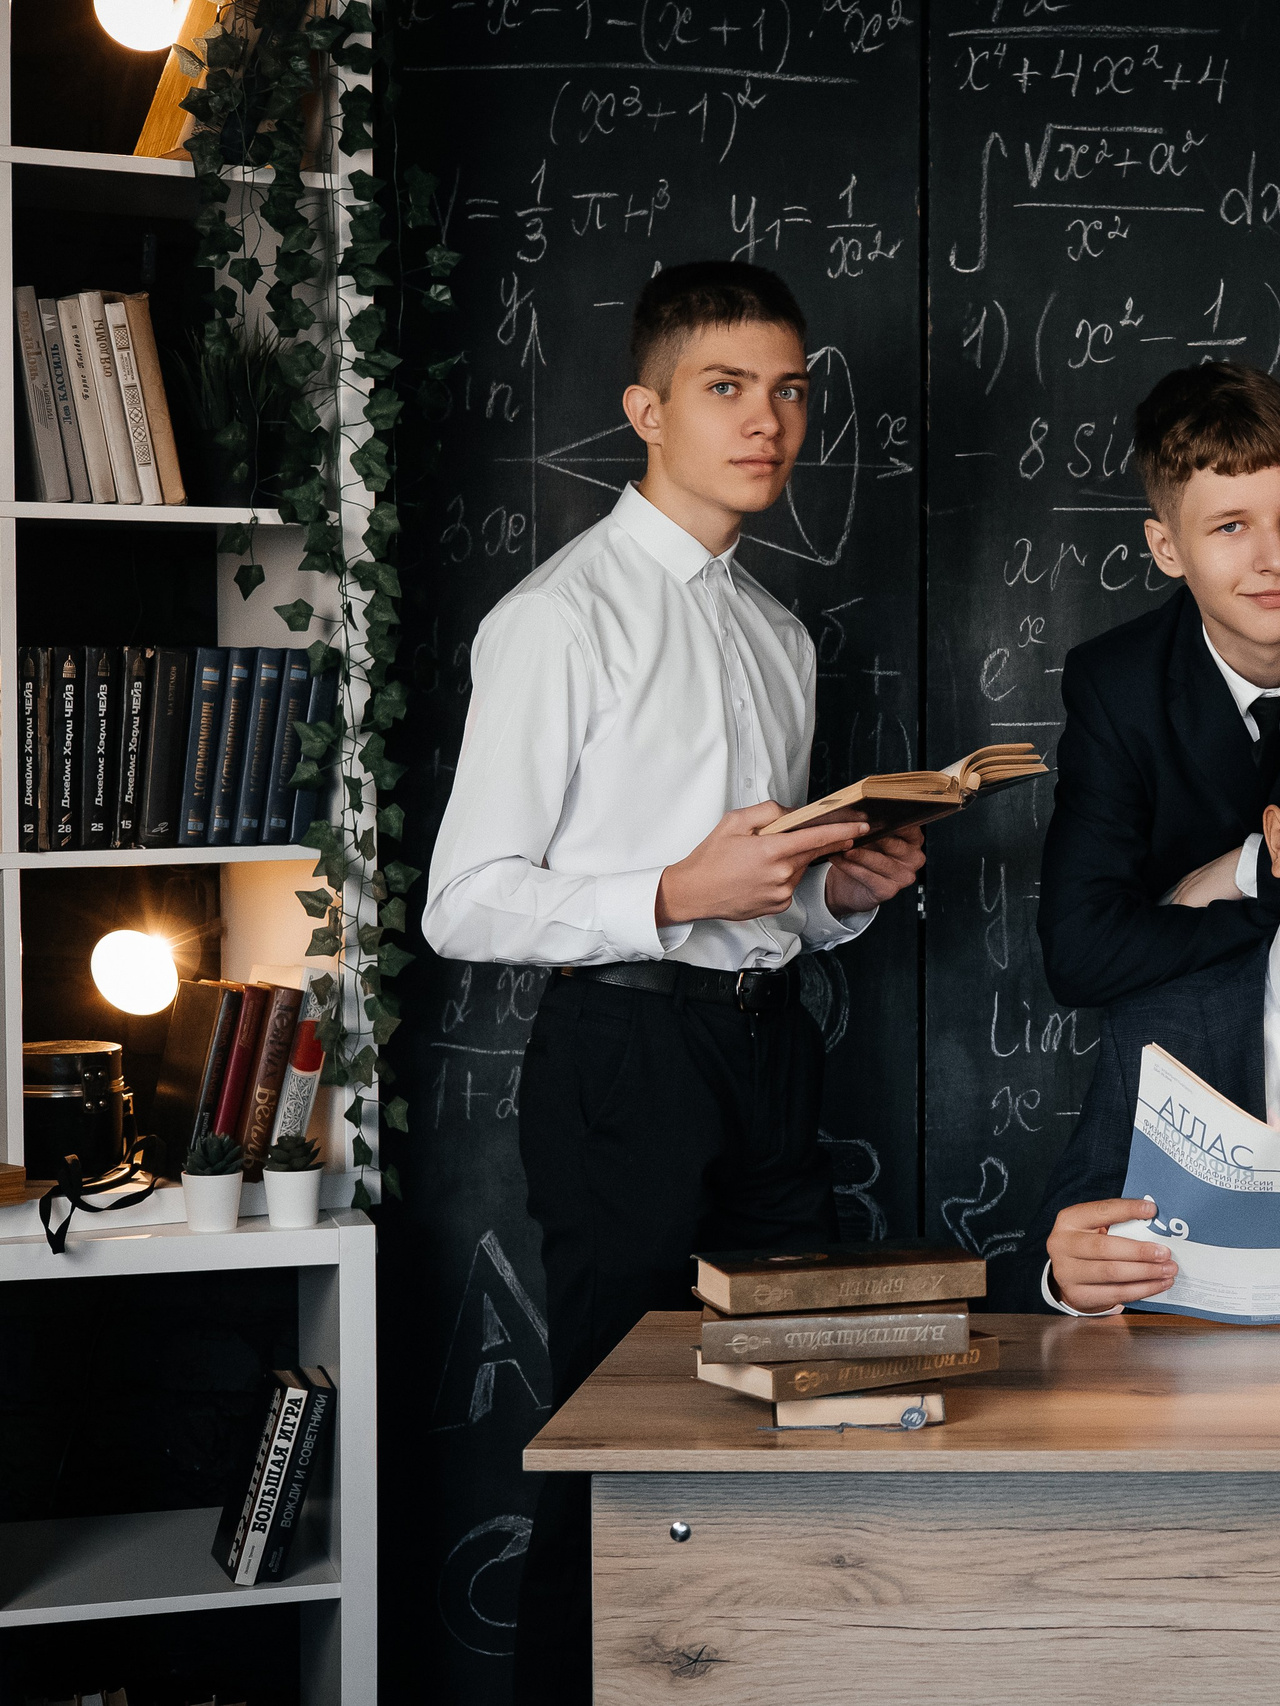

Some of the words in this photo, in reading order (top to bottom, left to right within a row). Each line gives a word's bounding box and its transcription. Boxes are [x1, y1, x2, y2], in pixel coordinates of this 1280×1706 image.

[51, 343, 69, 402] КАССИЛЬ
[24, 682, 33, 715] ЧЕЙЗ
[63, 684, 74, 718] ЧЕЙЗ
[97, 684, 108, 717] ЧЕЙЗ
[125, 754, 136, 804] Джеймс
[131, 681, 142, 715] ЧЕЙЗ
[24, 756, 33, 806] Джеймс
[61, 758, 72, 808] Джеймс
[95, 757, 105, 807] Джеймс
[23, 824, 34, 833] 12
[58, 825, 72, 833] 28
[91, 823, 104, 832] 25
[121, 820, 132, 829] 15
[1143, 1118, 1185, 1158] ФИЗИЧЕСКАЯ
[1187, 1154, 1232, 1182] ГЕОГРАФИЯ
[1234, 1178, 1274, 1187] РОССИИ
[1158, 1095, 1254, 1169] АТЛАС
[298, 1393, 328, 1467] СОВЕТНИКИ
[251, 1444, 290, 1535] БОЛЬШАЯ
[277, 1396, 304, 1443] ИГРА
[295, 1470, 307, 1480] И
[280, 1483, 303, 1528] ВОЖДИ
